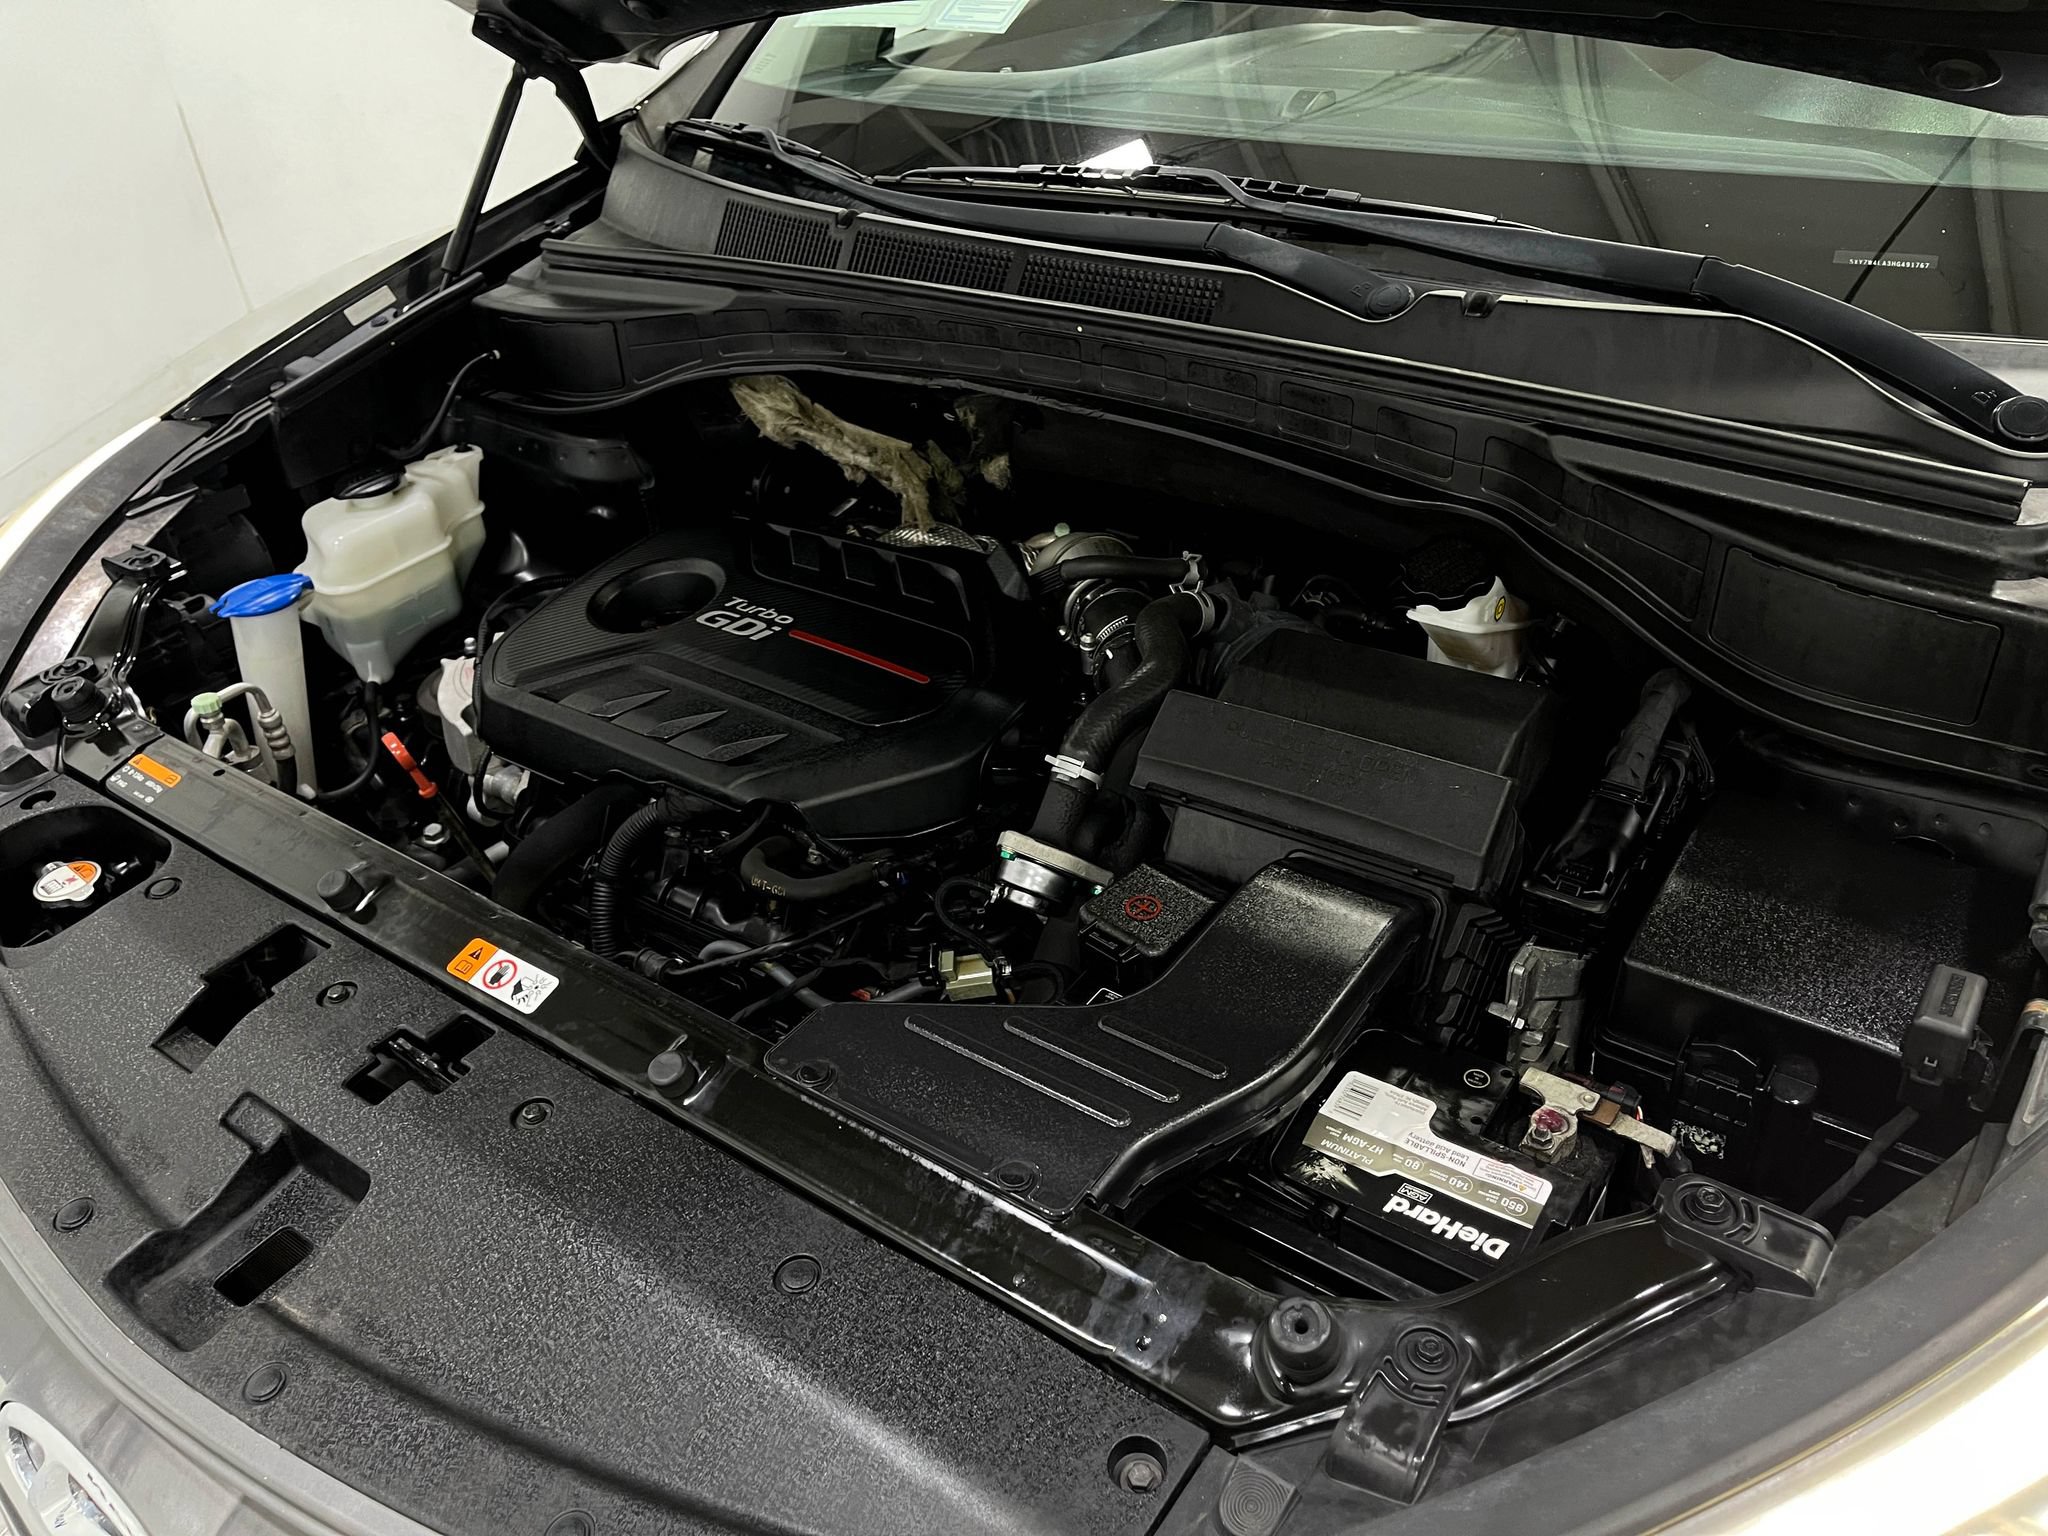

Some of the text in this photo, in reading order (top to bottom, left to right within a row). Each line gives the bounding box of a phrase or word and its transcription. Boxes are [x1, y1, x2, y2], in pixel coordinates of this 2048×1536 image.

[724, 596, 794, 624] Turbo
[696, 610, 782, 641] GDi
[1321, 1139, 1374, 1165] PLATINUM
[1342, 1133, 1384, 1156] H7-AGM
[1403, 1138, 1466, 1168] NON-SPILLABLE
[1449, 1177, 1470, 1191] 140
[1501, 1197, 1524, 1212] 850
[1382, 1196, 1510, 1260] DieHard
